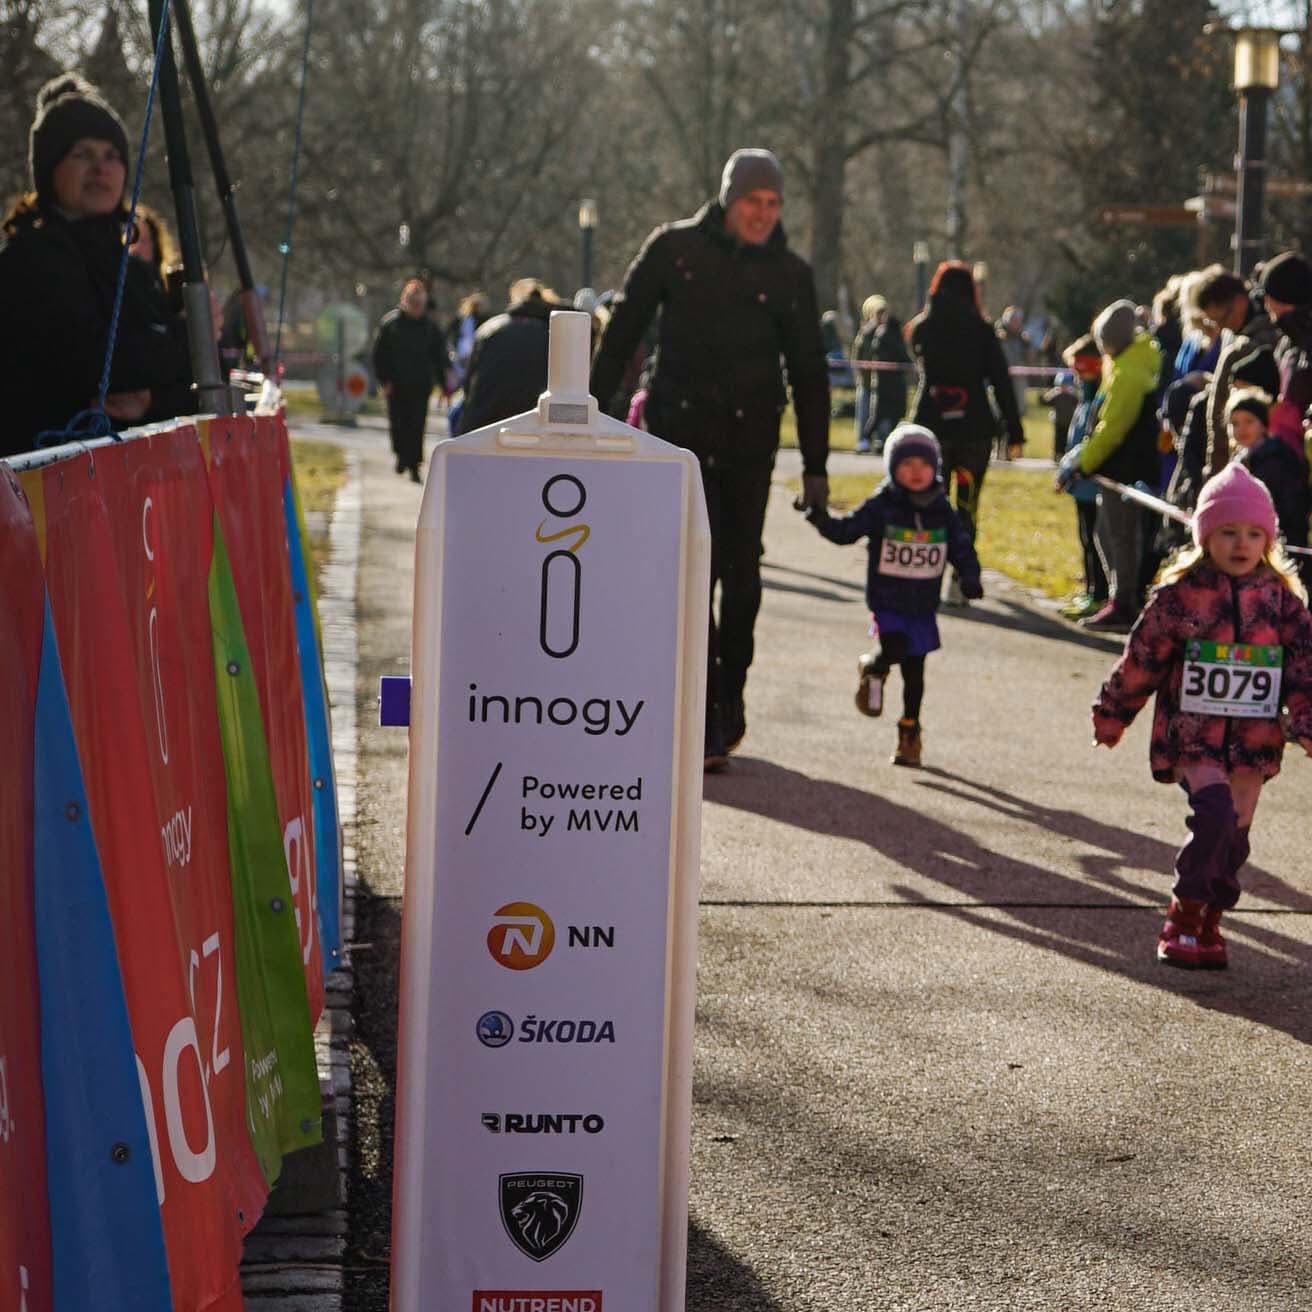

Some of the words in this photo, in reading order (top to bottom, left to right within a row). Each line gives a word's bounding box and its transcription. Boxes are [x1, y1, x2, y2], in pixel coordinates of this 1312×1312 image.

[885, 541, 941, 566] 3050
[1185, 665, 1272, 701] 3079
[468, 683, 645, 737] innogy
[521, 776, 642, 801] Powered
[520, 806, 555, 837] by
[567, 809, 639, 833] MVM
[567, 926, 615, 948] NN
[519, 1013, 617, 1044] ŠKODA
[505, 1114, 605, 1134] RUNTO
[507, 1179, 576, 1190] PEUGEOT
